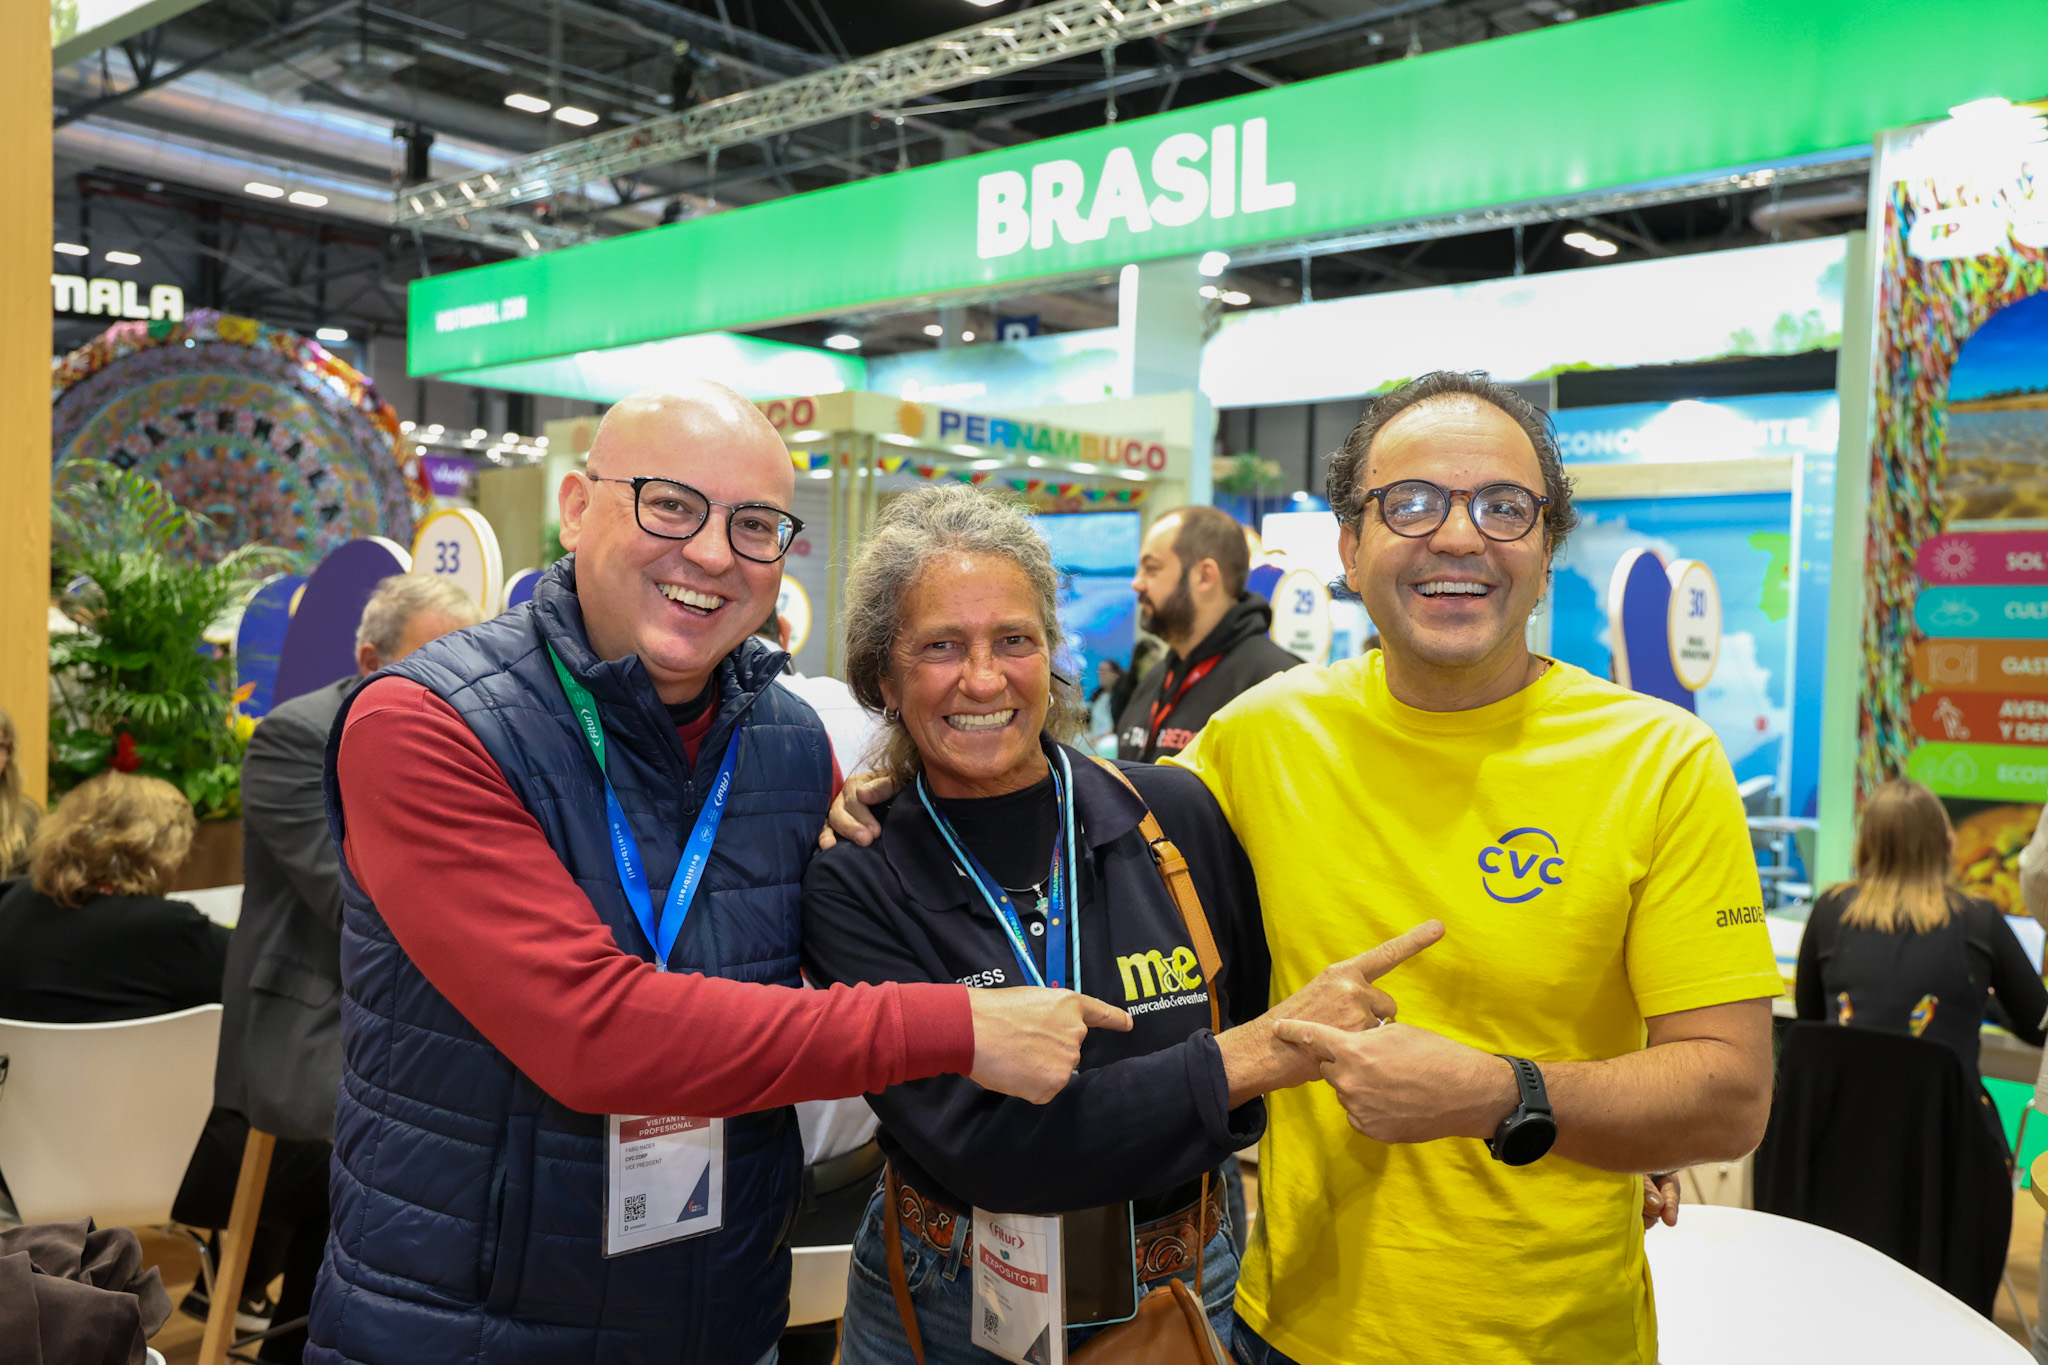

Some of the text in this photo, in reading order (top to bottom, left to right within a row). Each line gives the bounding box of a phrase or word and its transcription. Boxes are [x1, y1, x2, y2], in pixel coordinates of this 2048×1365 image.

[977, 116, 1296, 259] BRASIL
[939, 410, 1167, 471] PERNAMBUCO
[435, 541, 460, 573] 33
[2005, 551, 2046, 571] SOL
[613, 822, 636, 879] @visitbrasil
[1478, 846, 1565, 885] CVC
[676, 854, 701, 906] @visitbrasil
[1116, 945, 1203, 1001] m&e
[1127, 992, 1209, 1016] mercado&eventos
[638, 1121, 693, 1137] PROFESIONAL
[646, 1115, 686, 1127] VISITANTE
[625, 1158, 662, 1171] VICE PRESIDENT
[984, 1253, 1038, 1287] EXPOSITOR
